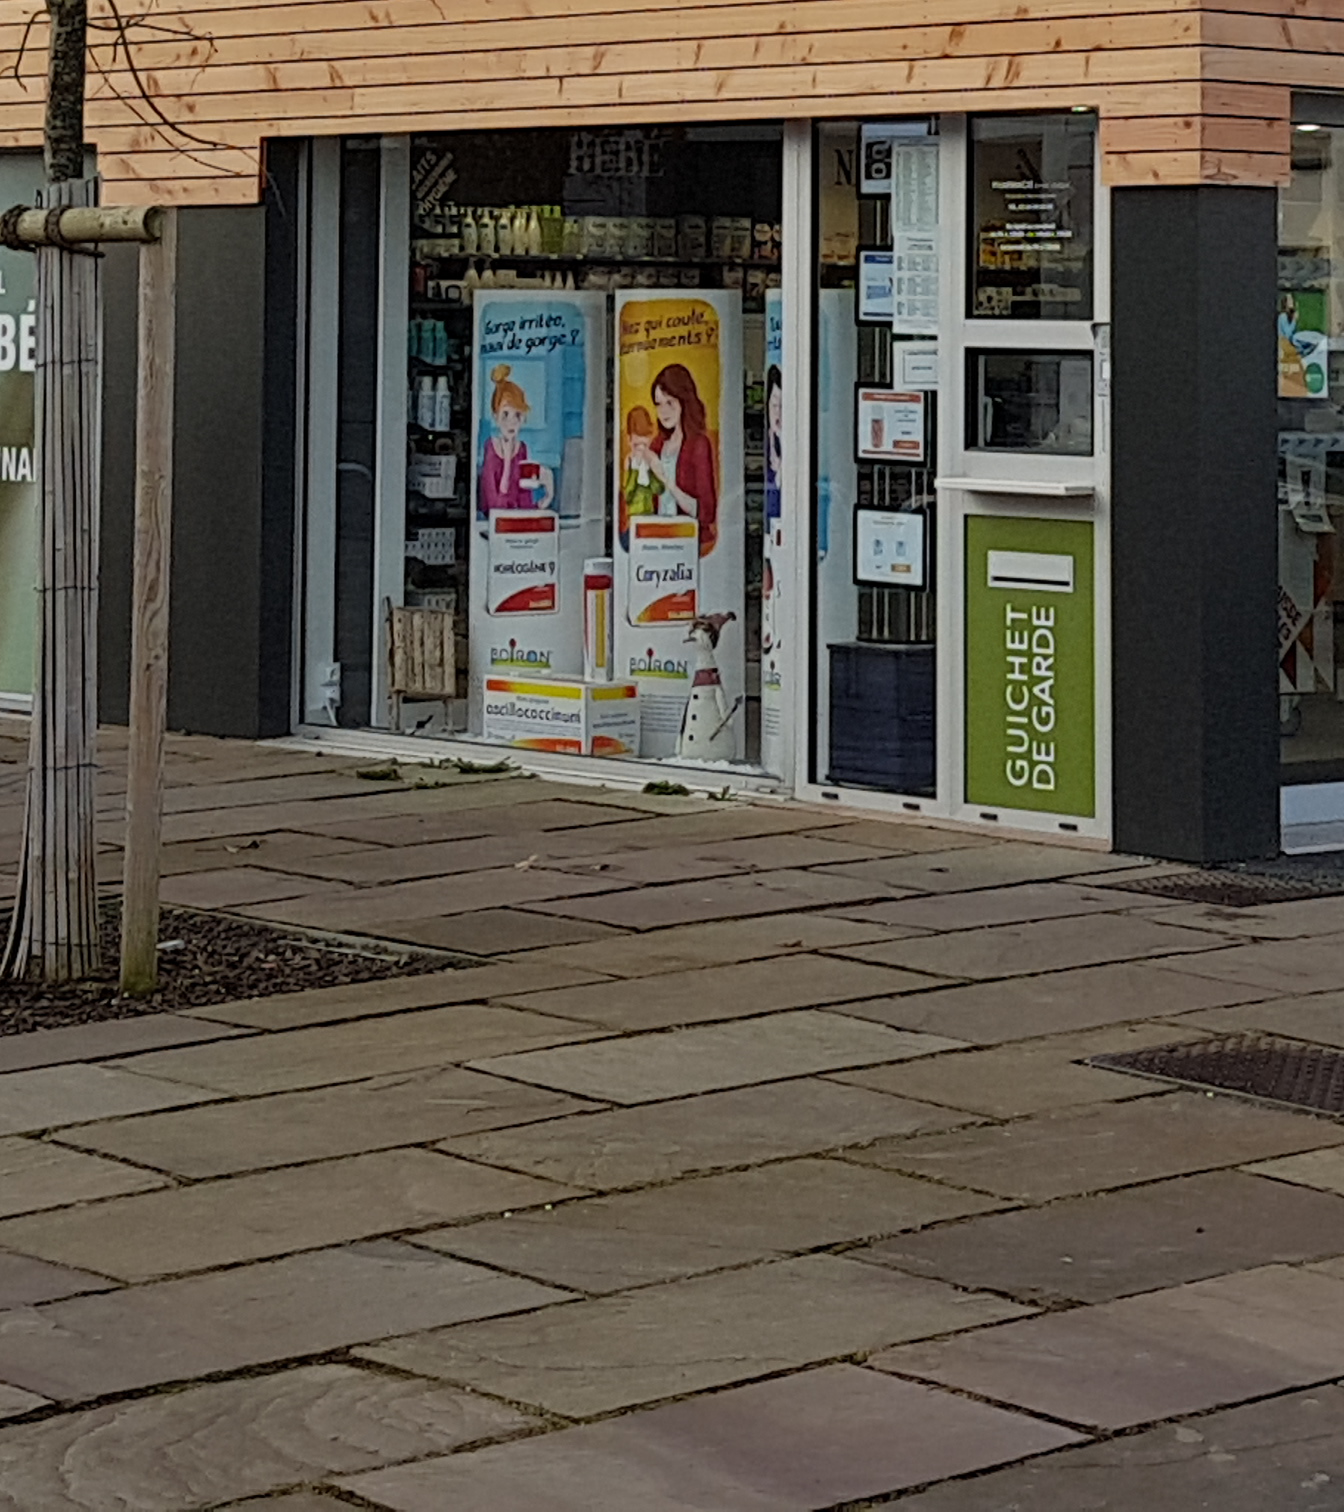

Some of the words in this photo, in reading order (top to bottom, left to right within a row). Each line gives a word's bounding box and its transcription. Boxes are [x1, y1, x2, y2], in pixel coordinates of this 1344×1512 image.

[1006, 603, 1029, 787] GUICHET
[1031, 605, 1055, 733] GARDE
[1031, 741, 1055, 791] DE
